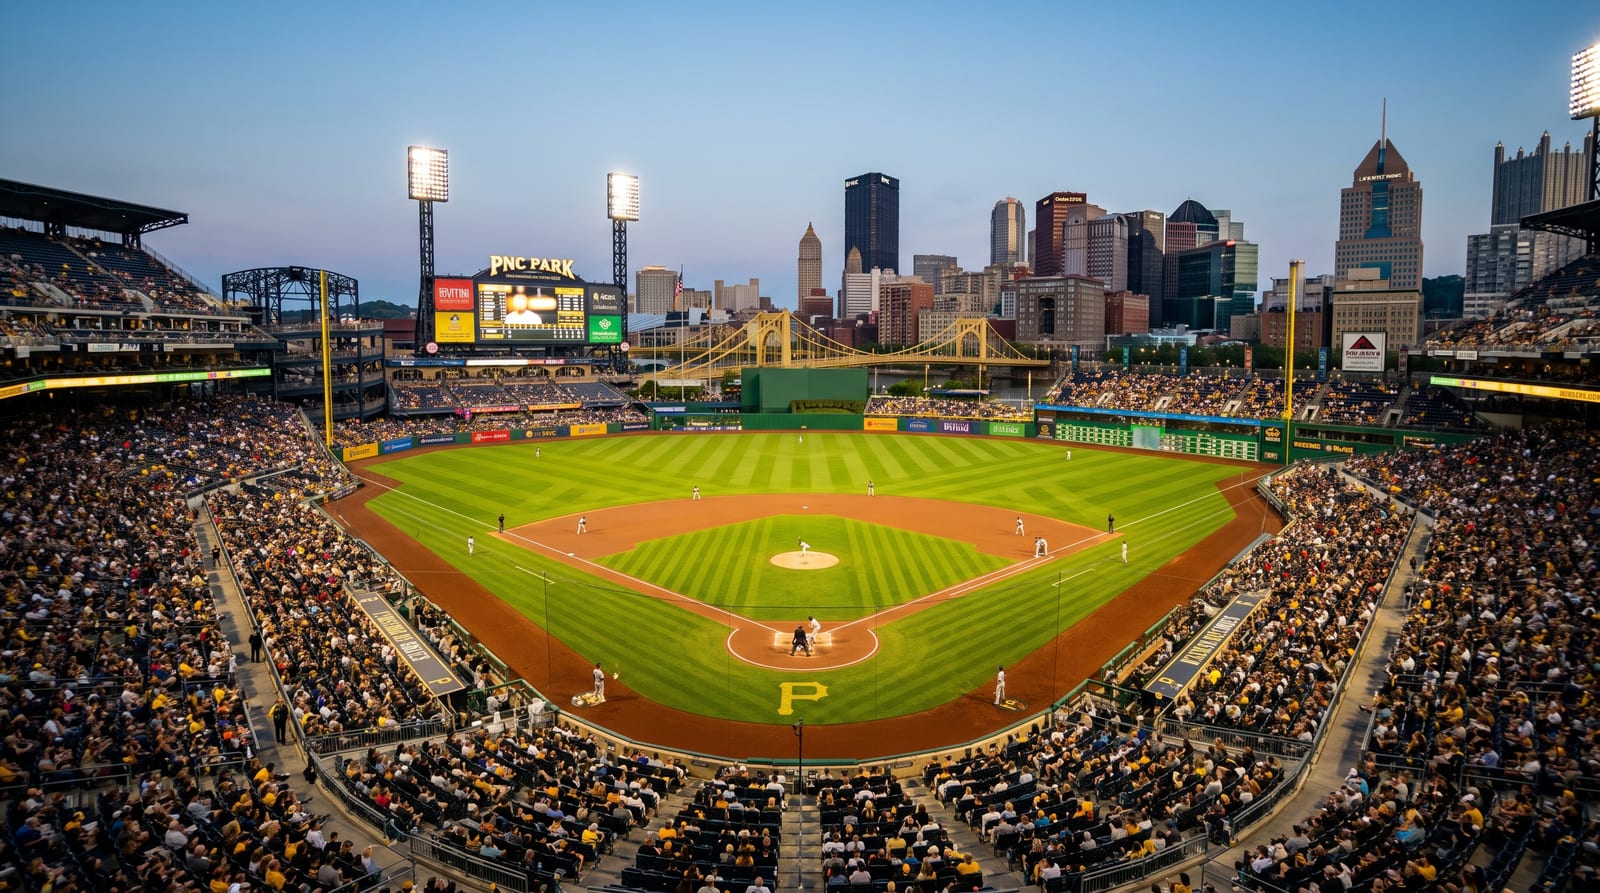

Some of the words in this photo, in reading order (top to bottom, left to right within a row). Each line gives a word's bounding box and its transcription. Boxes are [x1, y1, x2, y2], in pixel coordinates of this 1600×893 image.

[490, 255, 526, 277] PNC
[529, 257, 576, 280] PARK
[777, 681, 830, 716] P
